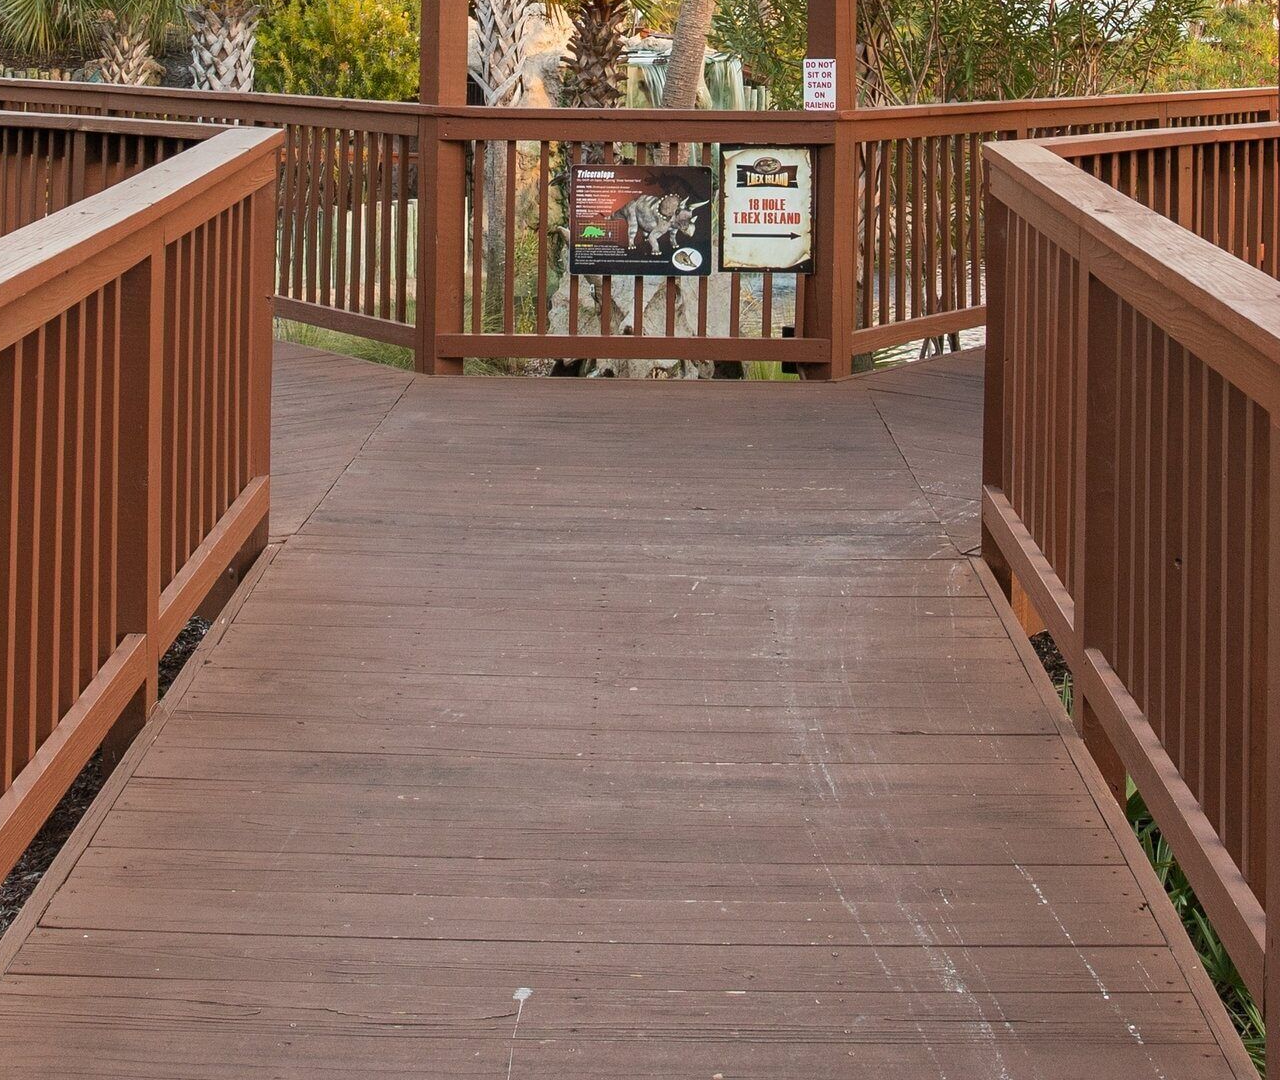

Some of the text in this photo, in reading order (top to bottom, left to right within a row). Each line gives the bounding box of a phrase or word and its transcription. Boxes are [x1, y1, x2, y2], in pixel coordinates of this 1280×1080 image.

[577, 169, 615, 180] Triceratops
[764, 171, 789, 187] ISLAND
[748, 198, 787, 211] 18 HOLE
[733, 211, 801, 225] T.REX ISLAND
